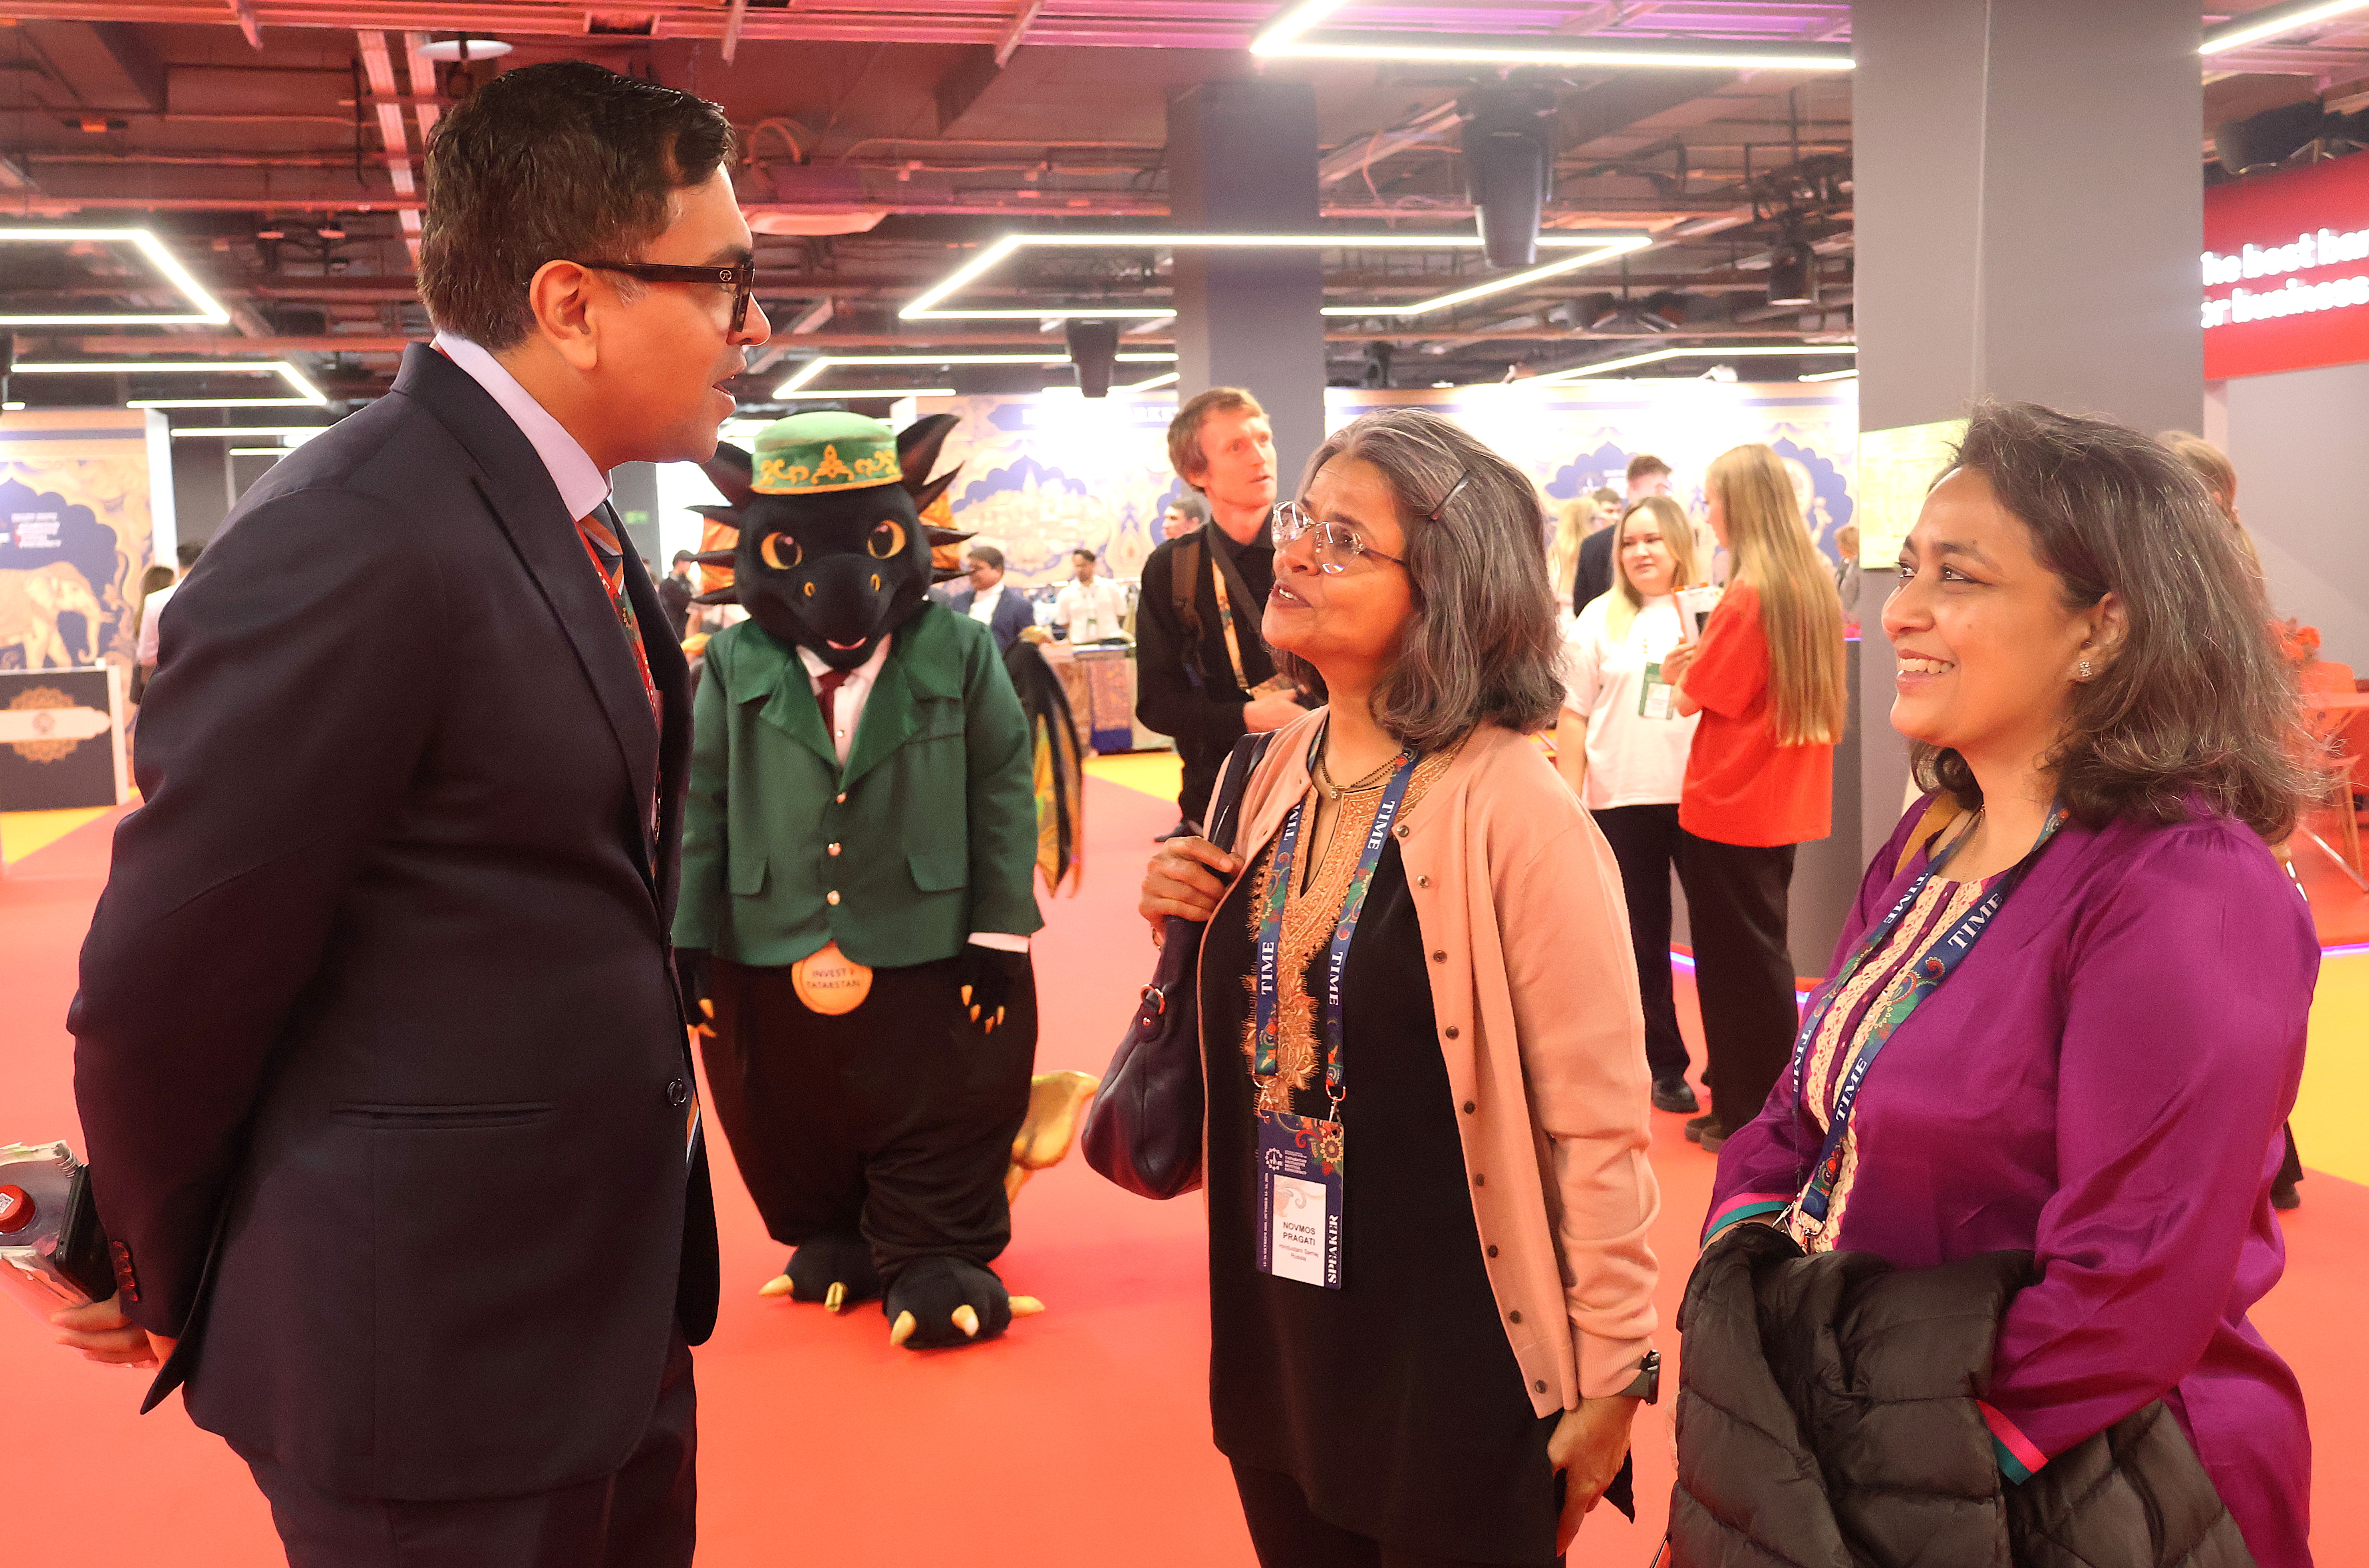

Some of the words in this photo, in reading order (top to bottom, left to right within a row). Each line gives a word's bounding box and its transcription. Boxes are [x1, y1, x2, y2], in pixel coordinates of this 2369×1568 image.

[2200, 251, 2242, 286] he
[2242, 233, 2316, 278] best
[1283, 804, 1300, 841] TIM
[1367, 801, 1395, 849] TIME
[1883, 873, 1929, 923] TIME
[1947, 893, 2002, 949] TIME
[1261, 942, 1274, 995] TIME
[1329, 951, 1343, 1006] TIME
[1793, 1030, 1812, 1092] TIME
[1836, 1058, 1867, 1121] TIME
[1283, 1222, 1315, 1235] NOVMOS
[1283, 1232, 1315, 1245] PRAGATI
[1328, 1215, 1338, 1283] SPEAKER
